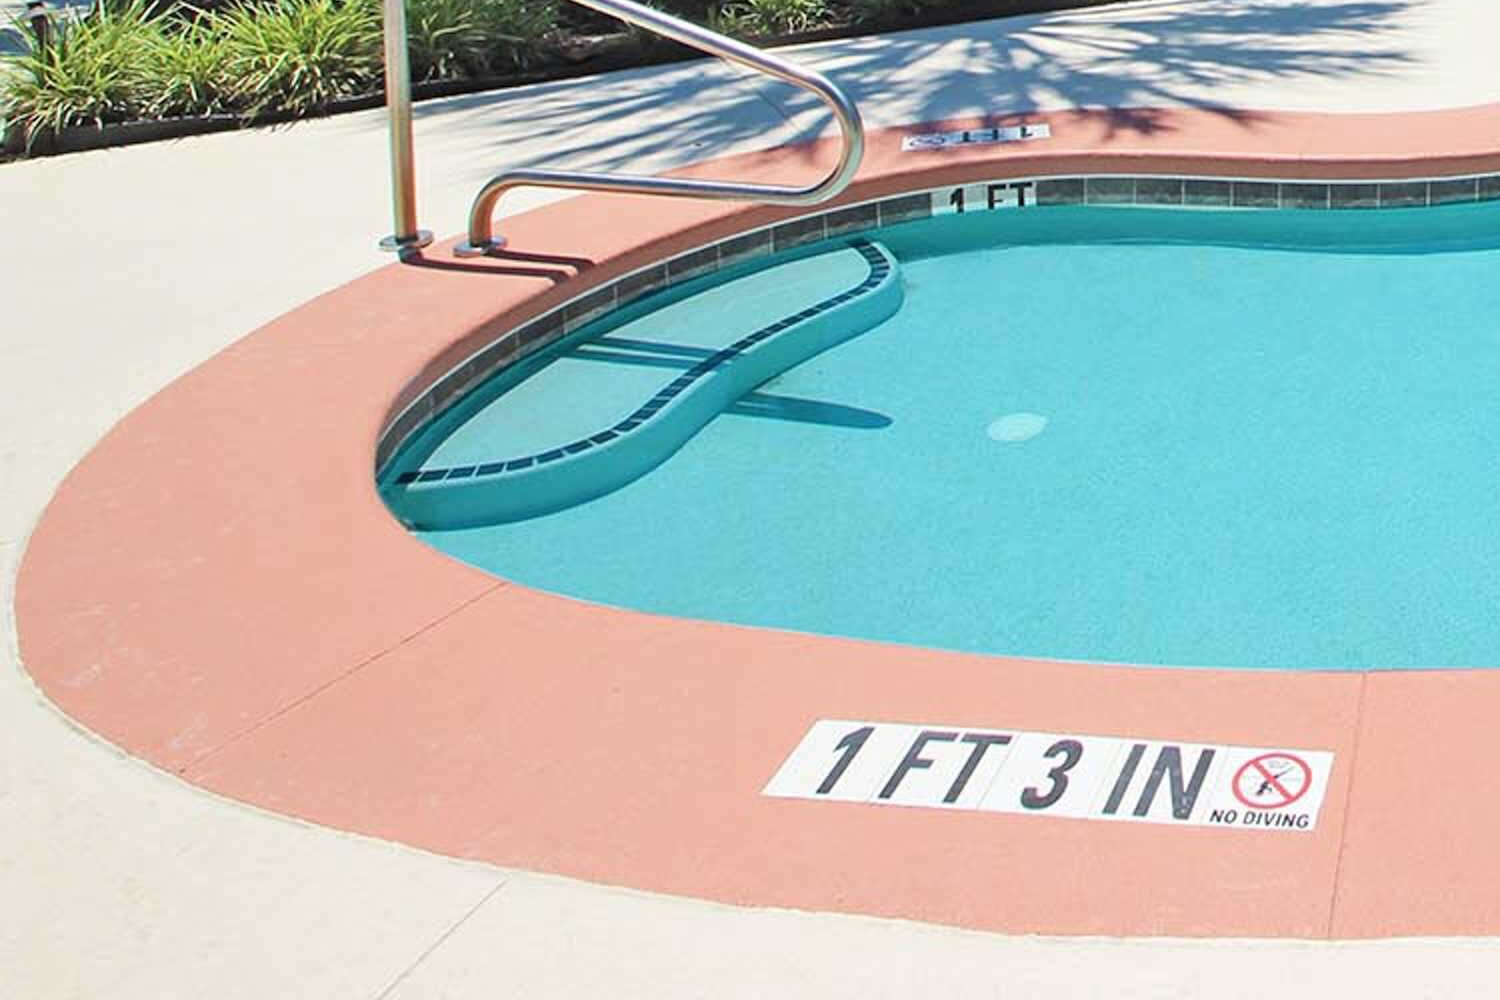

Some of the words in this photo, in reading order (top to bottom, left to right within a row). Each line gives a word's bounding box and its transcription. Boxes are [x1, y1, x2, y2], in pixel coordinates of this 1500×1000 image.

[949, 187, 964, 213] 1
[988, 181, 1033, 210] FT
[815, 726, 876, 795] 1
[878, 730, 1012, 804] FT
[1020, 739, 1084, 810] 3
[1102, 744, 1216, 821] IN
[1208, 809, 1238, 825] NO
[1242, 810, 1310, 829] DIVING
